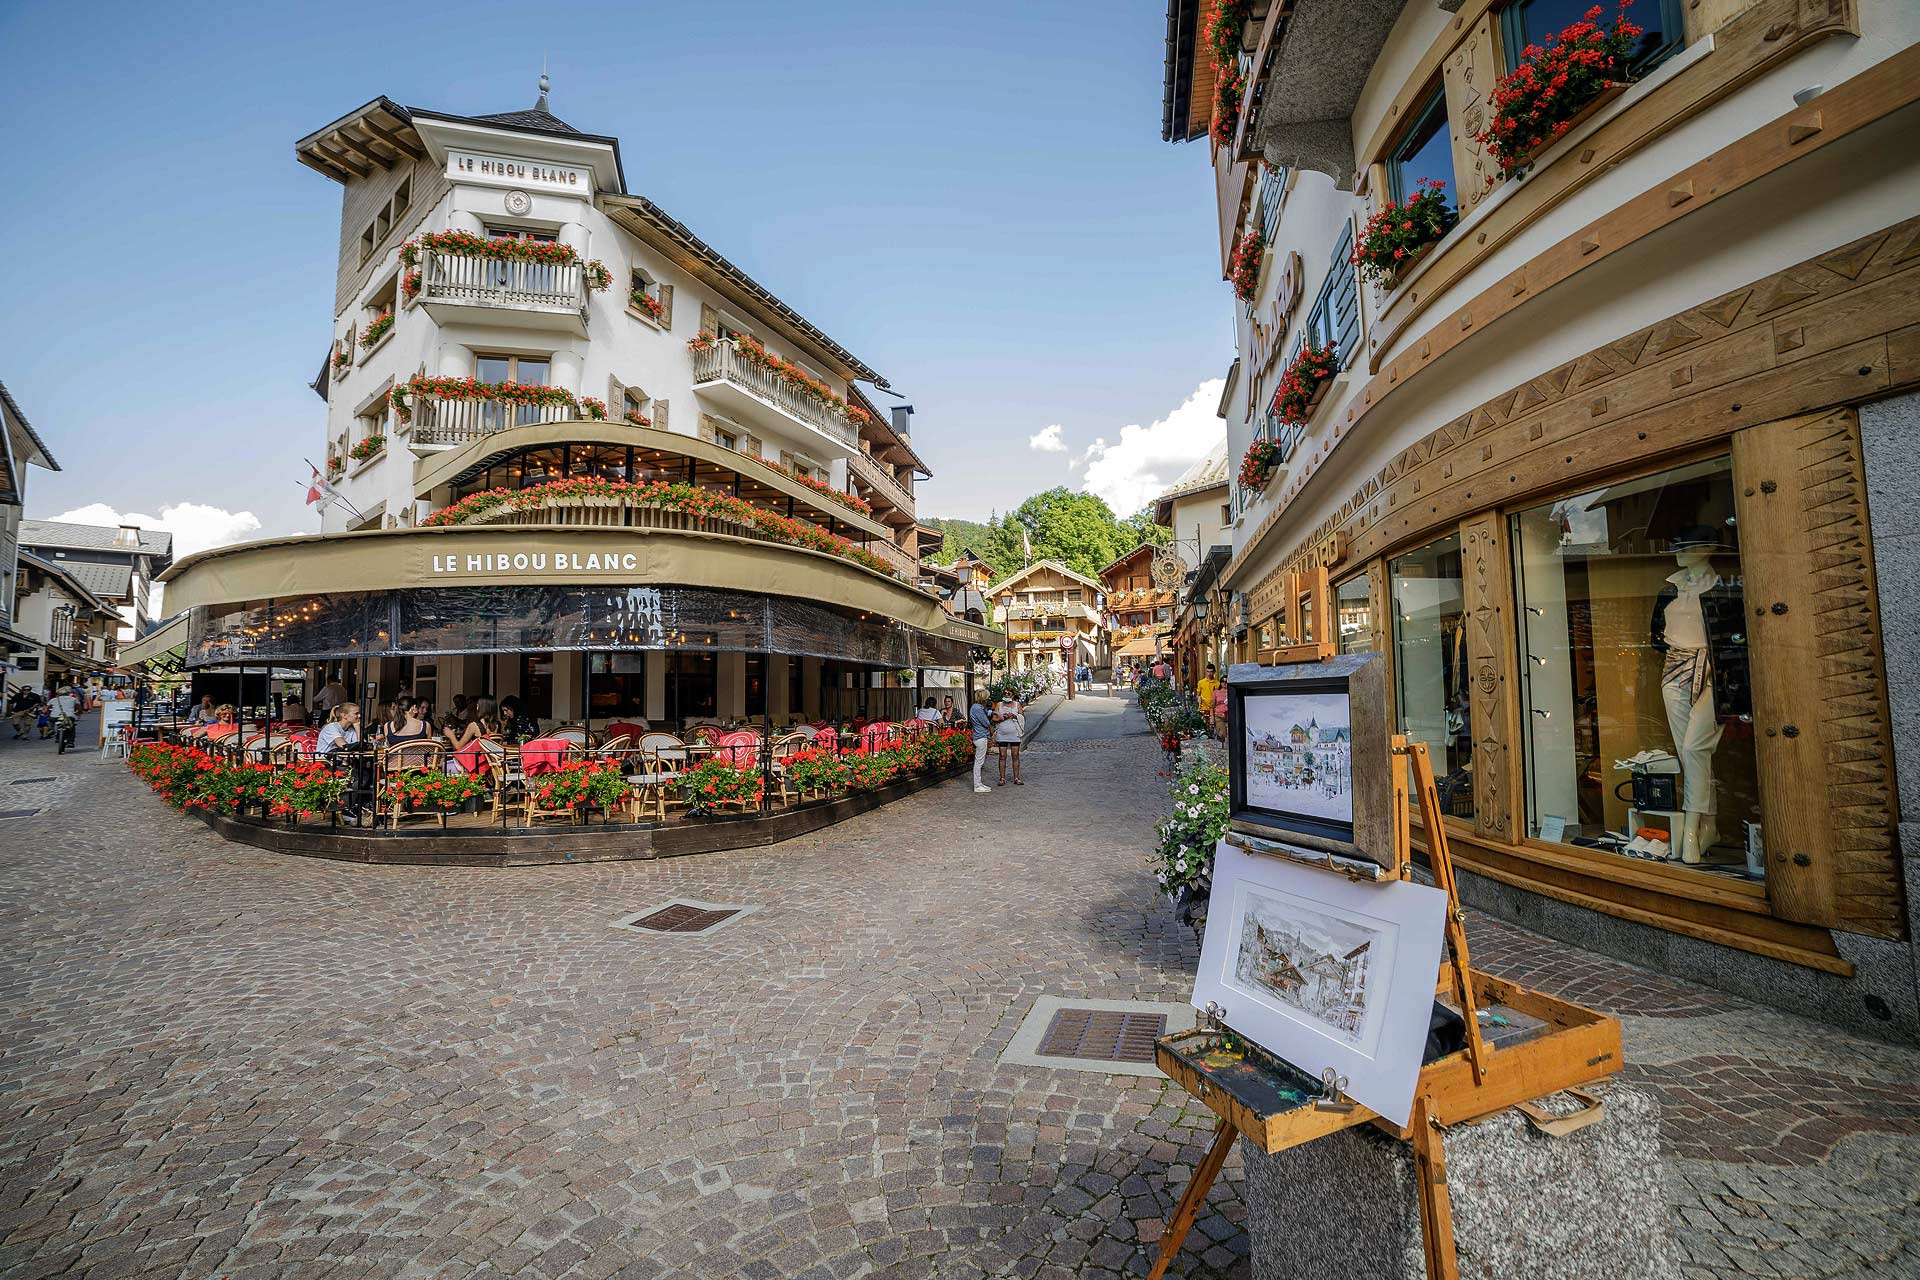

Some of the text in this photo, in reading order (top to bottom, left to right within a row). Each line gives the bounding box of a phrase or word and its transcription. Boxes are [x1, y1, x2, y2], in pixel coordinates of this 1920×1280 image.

[458, 157, 577, 185] LE HIBOU BLANC
[432, 553, 638, 573] LE HIBOU BLANC
[955, 627, 967, 638] HIBOU
